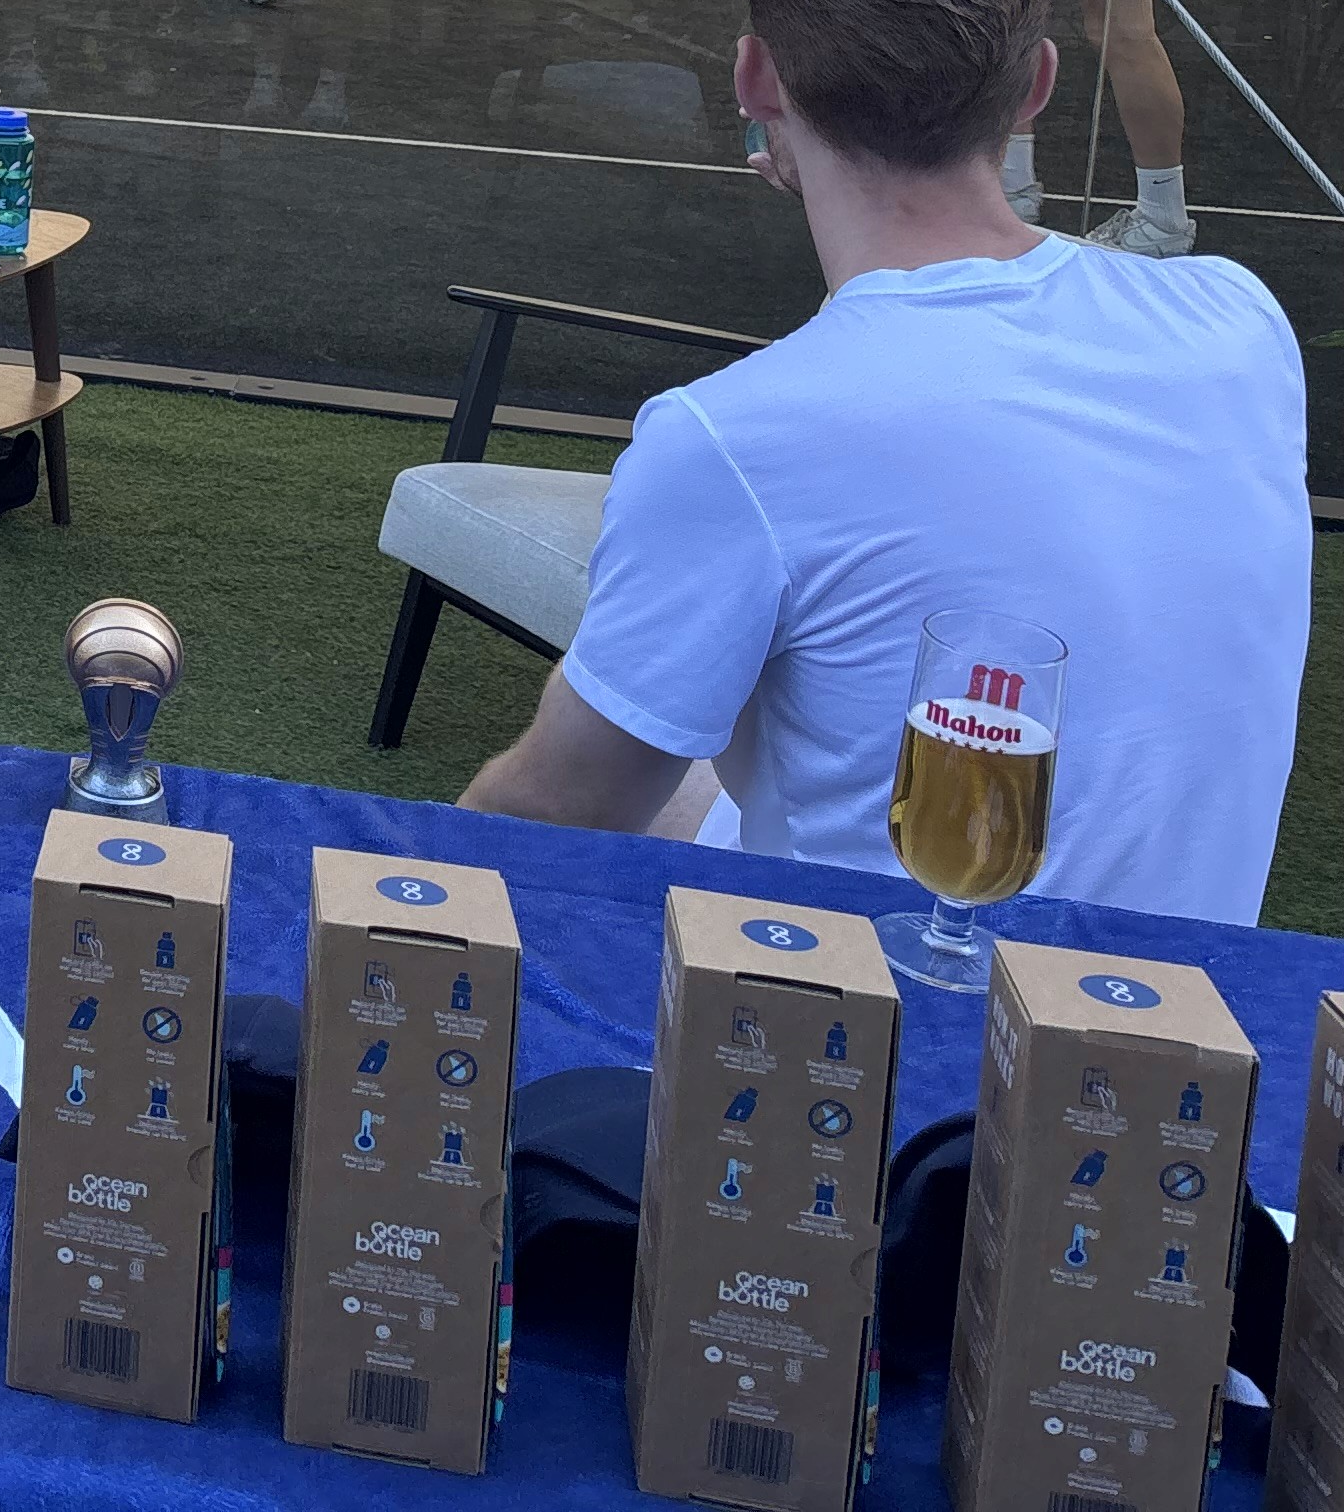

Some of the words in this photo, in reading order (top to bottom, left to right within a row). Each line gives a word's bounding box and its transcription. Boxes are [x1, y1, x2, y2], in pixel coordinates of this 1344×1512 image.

[67, 1183, 132, 1213] bottle
[82, 1173, 148, 1198] ocean
[355, 1231, 423, 1262] bottle
[370, 1220, 441, 1246] ocean
[718, 1279, 790, 1313] bottle
[735, 1270, 809, 1298] ocean
[1060, 1349, 1136, 1382] bottle
[1078, 1339, 1157, 1367] ocean
